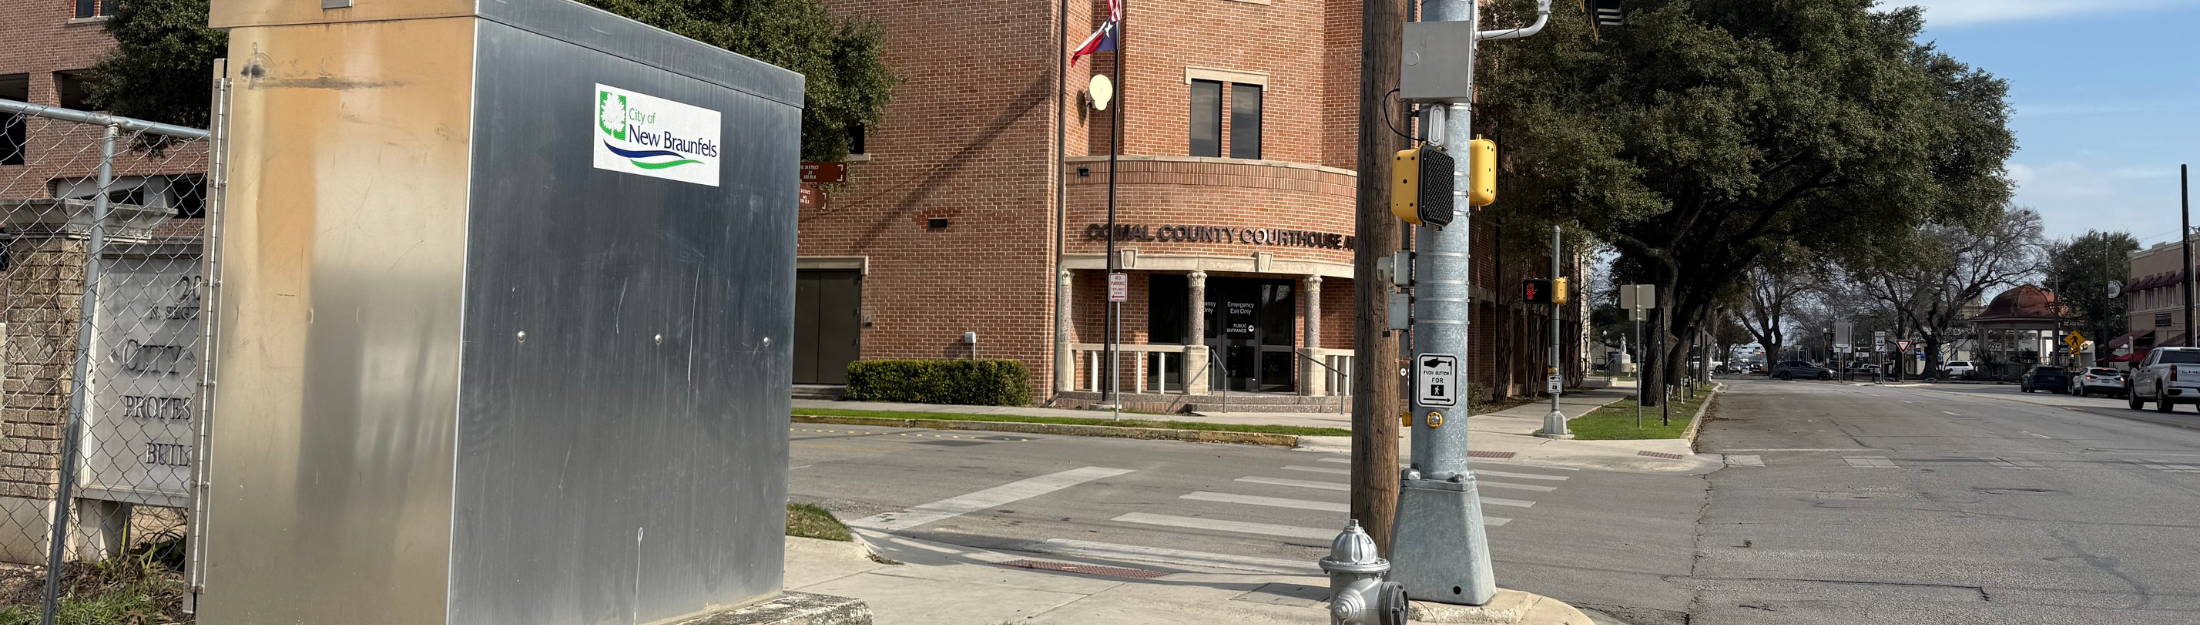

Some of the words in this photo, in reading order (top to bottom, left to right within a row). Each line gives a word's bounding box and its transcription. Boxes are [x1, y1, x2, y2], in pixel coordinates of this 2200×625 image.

[629, 107, 646, 125] City
[647, 112, 656, 124] of
[629, 124, 661, 147] New
[664, 131, 717, 158] Braunfels
[1157, 225, 1237, 243] COUNTY
[1240, 228, 1342, 250] COURTHOUSE
[180, 276, 201, 300] 20
[123, 338, 182, 374] CITY
[123, 395, 193, 420] PROFES
[145, 442, 192, 467] BUIL
